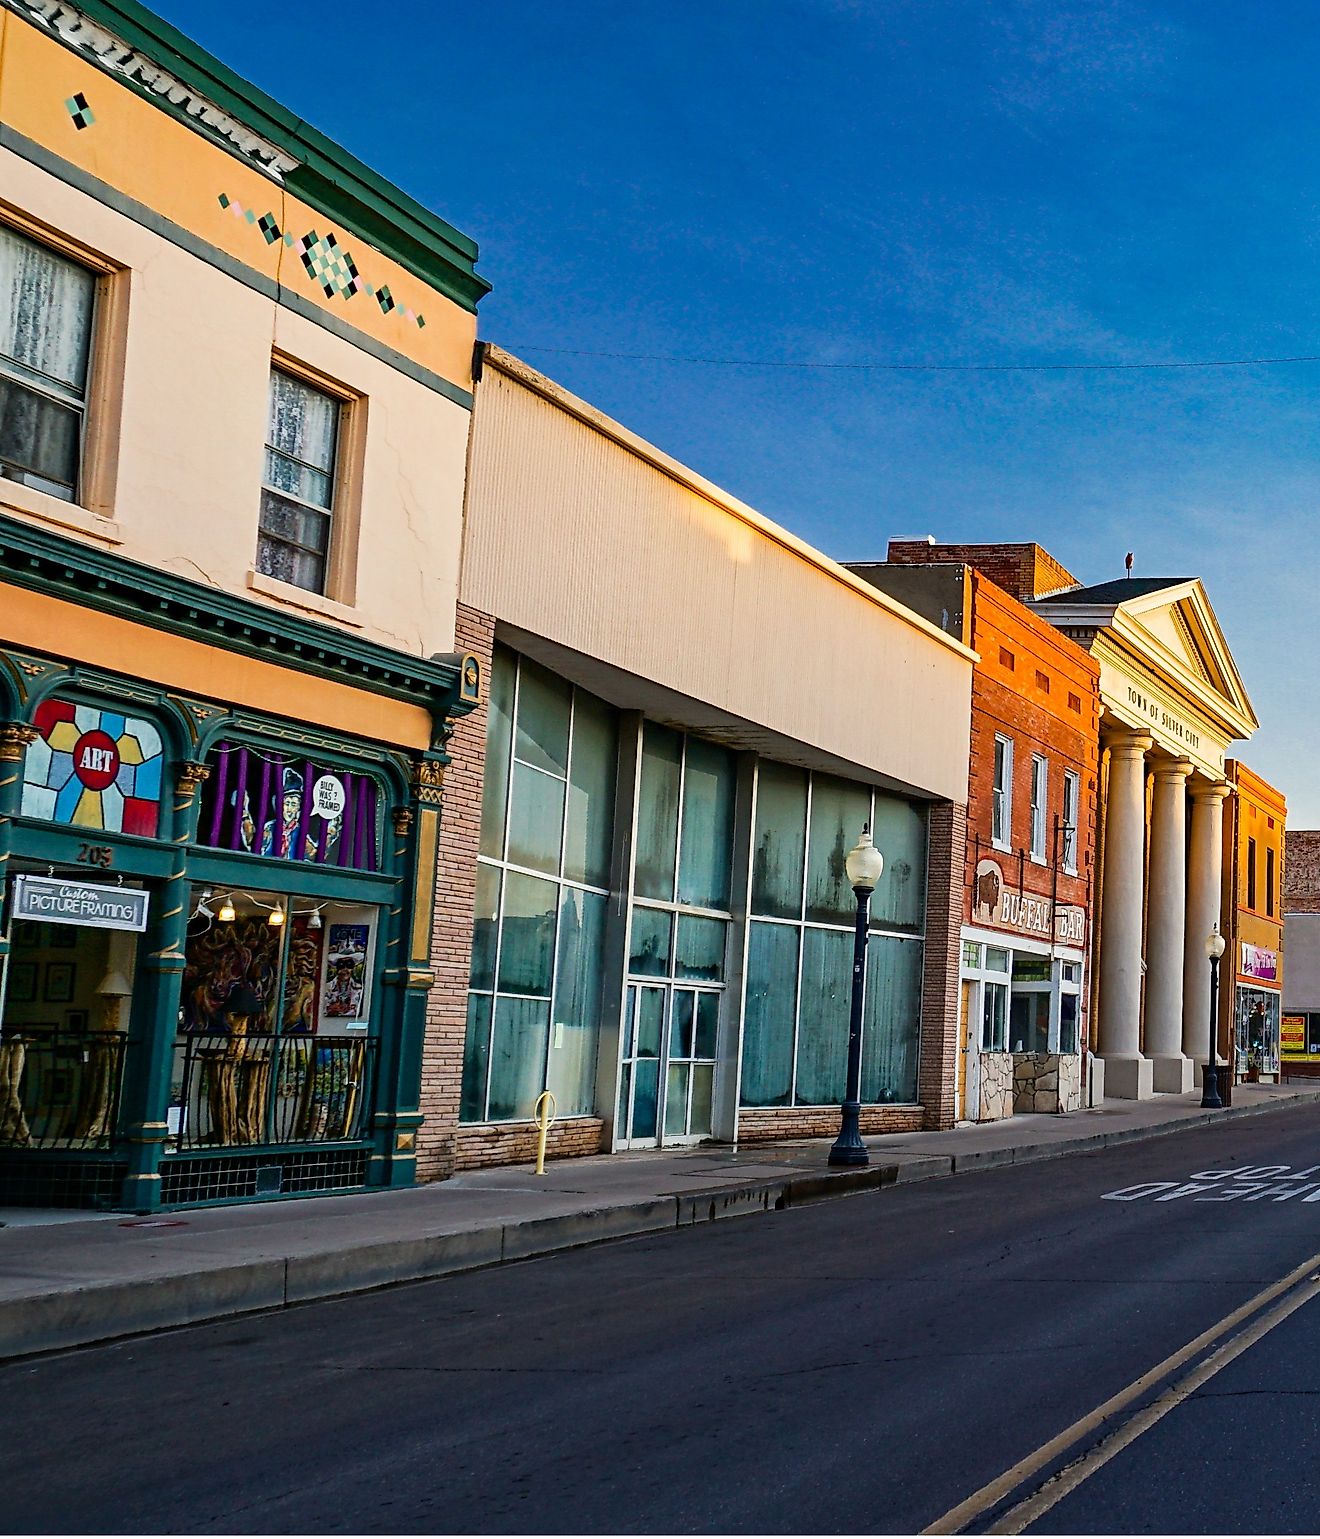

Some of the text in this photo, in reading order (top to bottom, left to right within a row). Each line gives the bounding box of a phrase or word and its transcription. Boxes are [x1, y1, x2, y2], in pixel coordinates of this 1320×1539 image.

[1127, 686, 1200, 749] TOWN OF SILVER CITY
[79, 746, 114, 773] ART
[319, 790, 332, 801] WAS
[59, 885, 100, 901] Custom
[29, 894, 133, 920] PICTURE FRAMING
[1000, 892, 1083, 940] BUFFAL BAR
